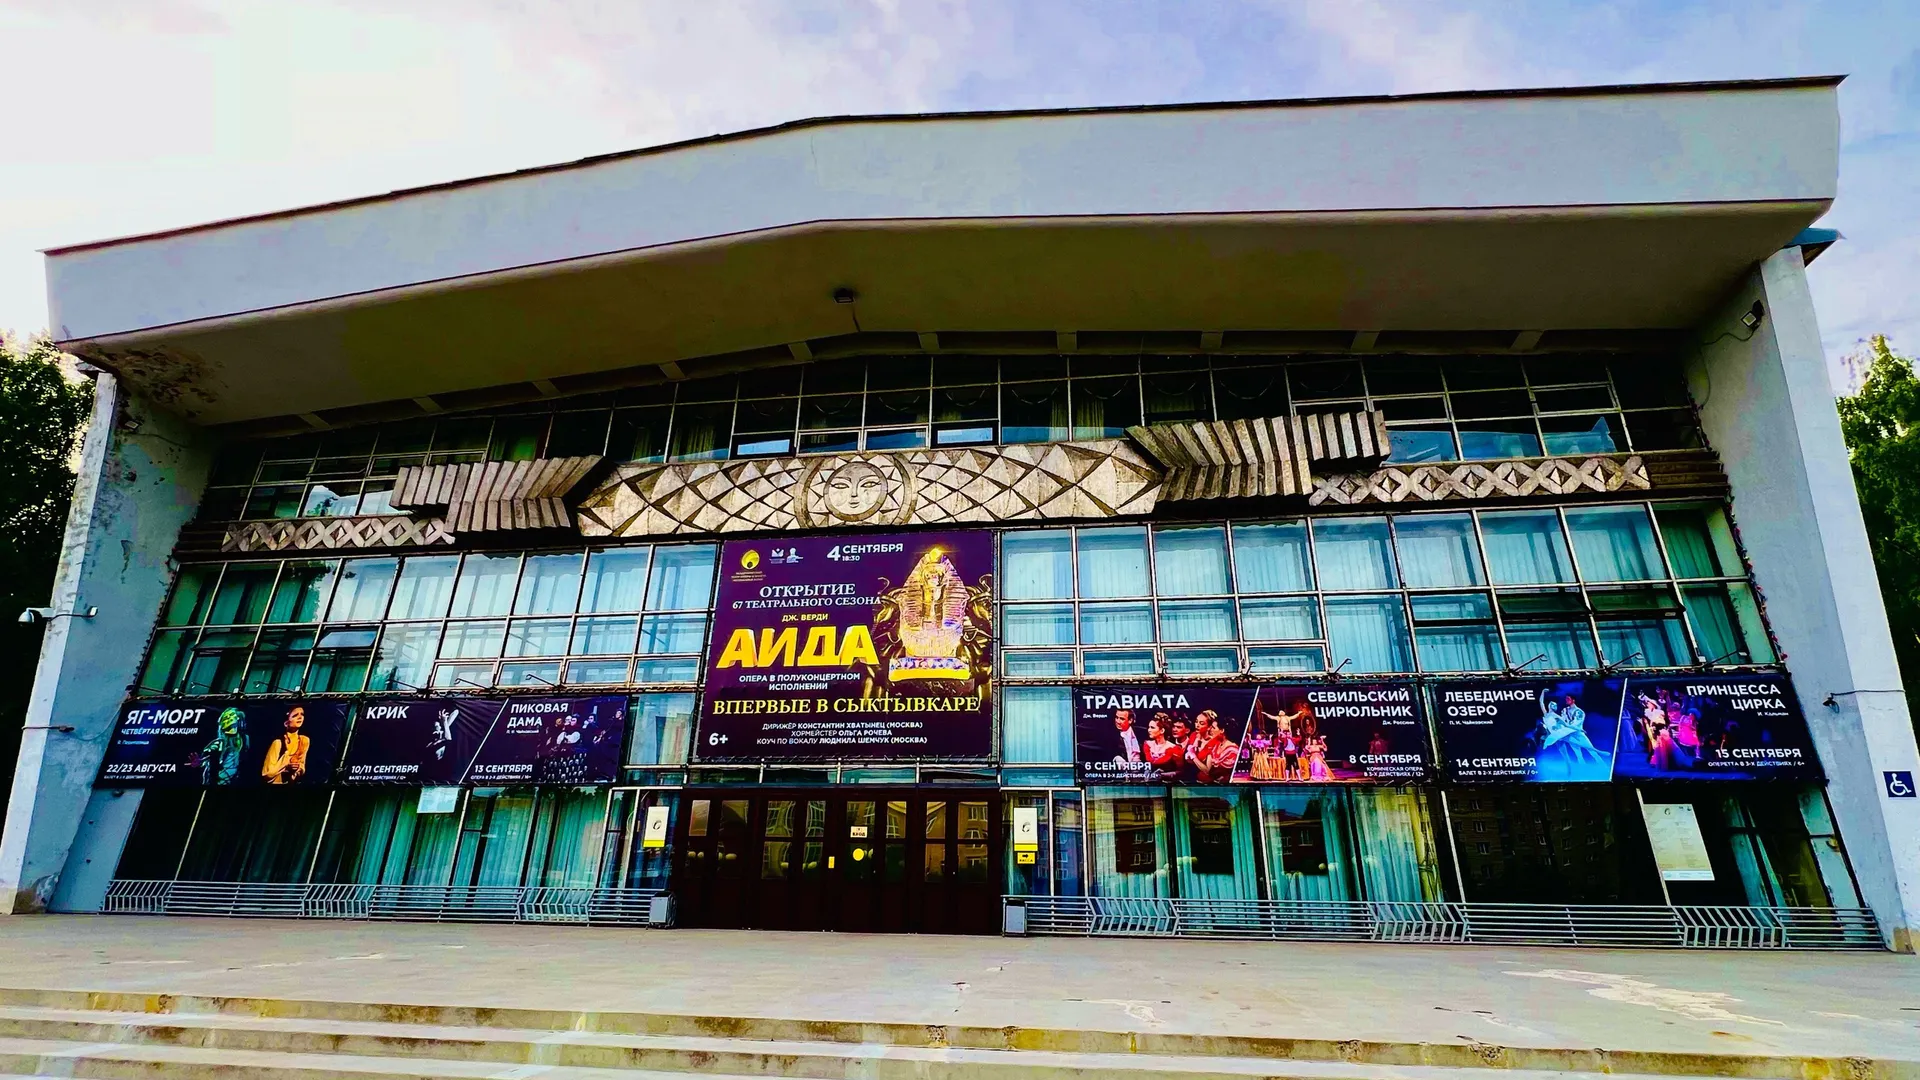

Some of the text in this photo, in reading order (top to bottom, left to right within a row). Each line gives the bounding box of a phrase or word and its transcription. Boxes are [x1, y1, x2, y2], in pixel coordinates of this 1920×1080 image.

[827, 543, 903, 561] 4 СЕНТЯБРЯ
[759, 583, 856, 598] ОТКРЫТИЕ
[732, 595, 882, 609] 67 ТЕАТРАЛЬНОГО СЕЗОНА
[782, 613, 829, 623] ДЖ. ВЕРДИ
[715, 624, 881, 669] АИДА
[739, 672, 860, 682] ОПЕРА В ПОЛУКОНЦЕРТНОМ
[768, 683, 828, 691] ИСПОЛНЕНИИ
[1686, 684, 1781, 697] ПРИНЦЕССА
[1307, 688, 1410, 702] СЕВИЛЬСКИЙ
[1444, 690, 1536, 703] ЛЕБЕДИНОЕ
[712, 696, 980, 715] ВПЕРВЫЕ В СЫКТЫВКАРЕ
[1082, 694, 1190, 709] ТРАВИАТА
[1731, 698, 1786, 711] ЦИРКА
[366, 705, 410, 720] КРИК
[510, 703, 569, 714] ПИКОВАЯ
[1314, 705, 1413, 719] ЦИРЮЛЬНИК
[1447, 705, 1498, 717] ОЗЕРО
[124, 708, 206, 725] ЯГ-МОРТ
[506, 716, 543, 729] ДАМА
[121, 727, 198, 736] ЧЕТВЁРТАЯ РЕДАКЦИЯ
[762, 722, 796, 731] ДИРИЖЁР
[886, 721, 923, 729] (МОСКВА)
[709, 732, 728, 746] 6+
[791, 729, 837, 737] ХОРМЕЙСТЕР
[819, 737, 856, 745] ЛЮДМИЛА
[890, 736, 927, 744] (МОСКВА)
[1349, 754, 1422, 764] 8 СЕНТЯБРЯ
[1715, 748, 1802, 758] 15 СЕНТЯБРЯ
[106, 763, 176, 774] 22/23 АВГУСТА
[474, 764, 533, 773] 13 СЕНТЯБРЯ
[1084, 761, 1152, 770] 6 СЕНТЯБРЯ
[1456, 757, 1536, 768] 14 СЕНТЯБРЯ
[351, 764, 419, 774] 10/11 СЕНТЯБРЯ
